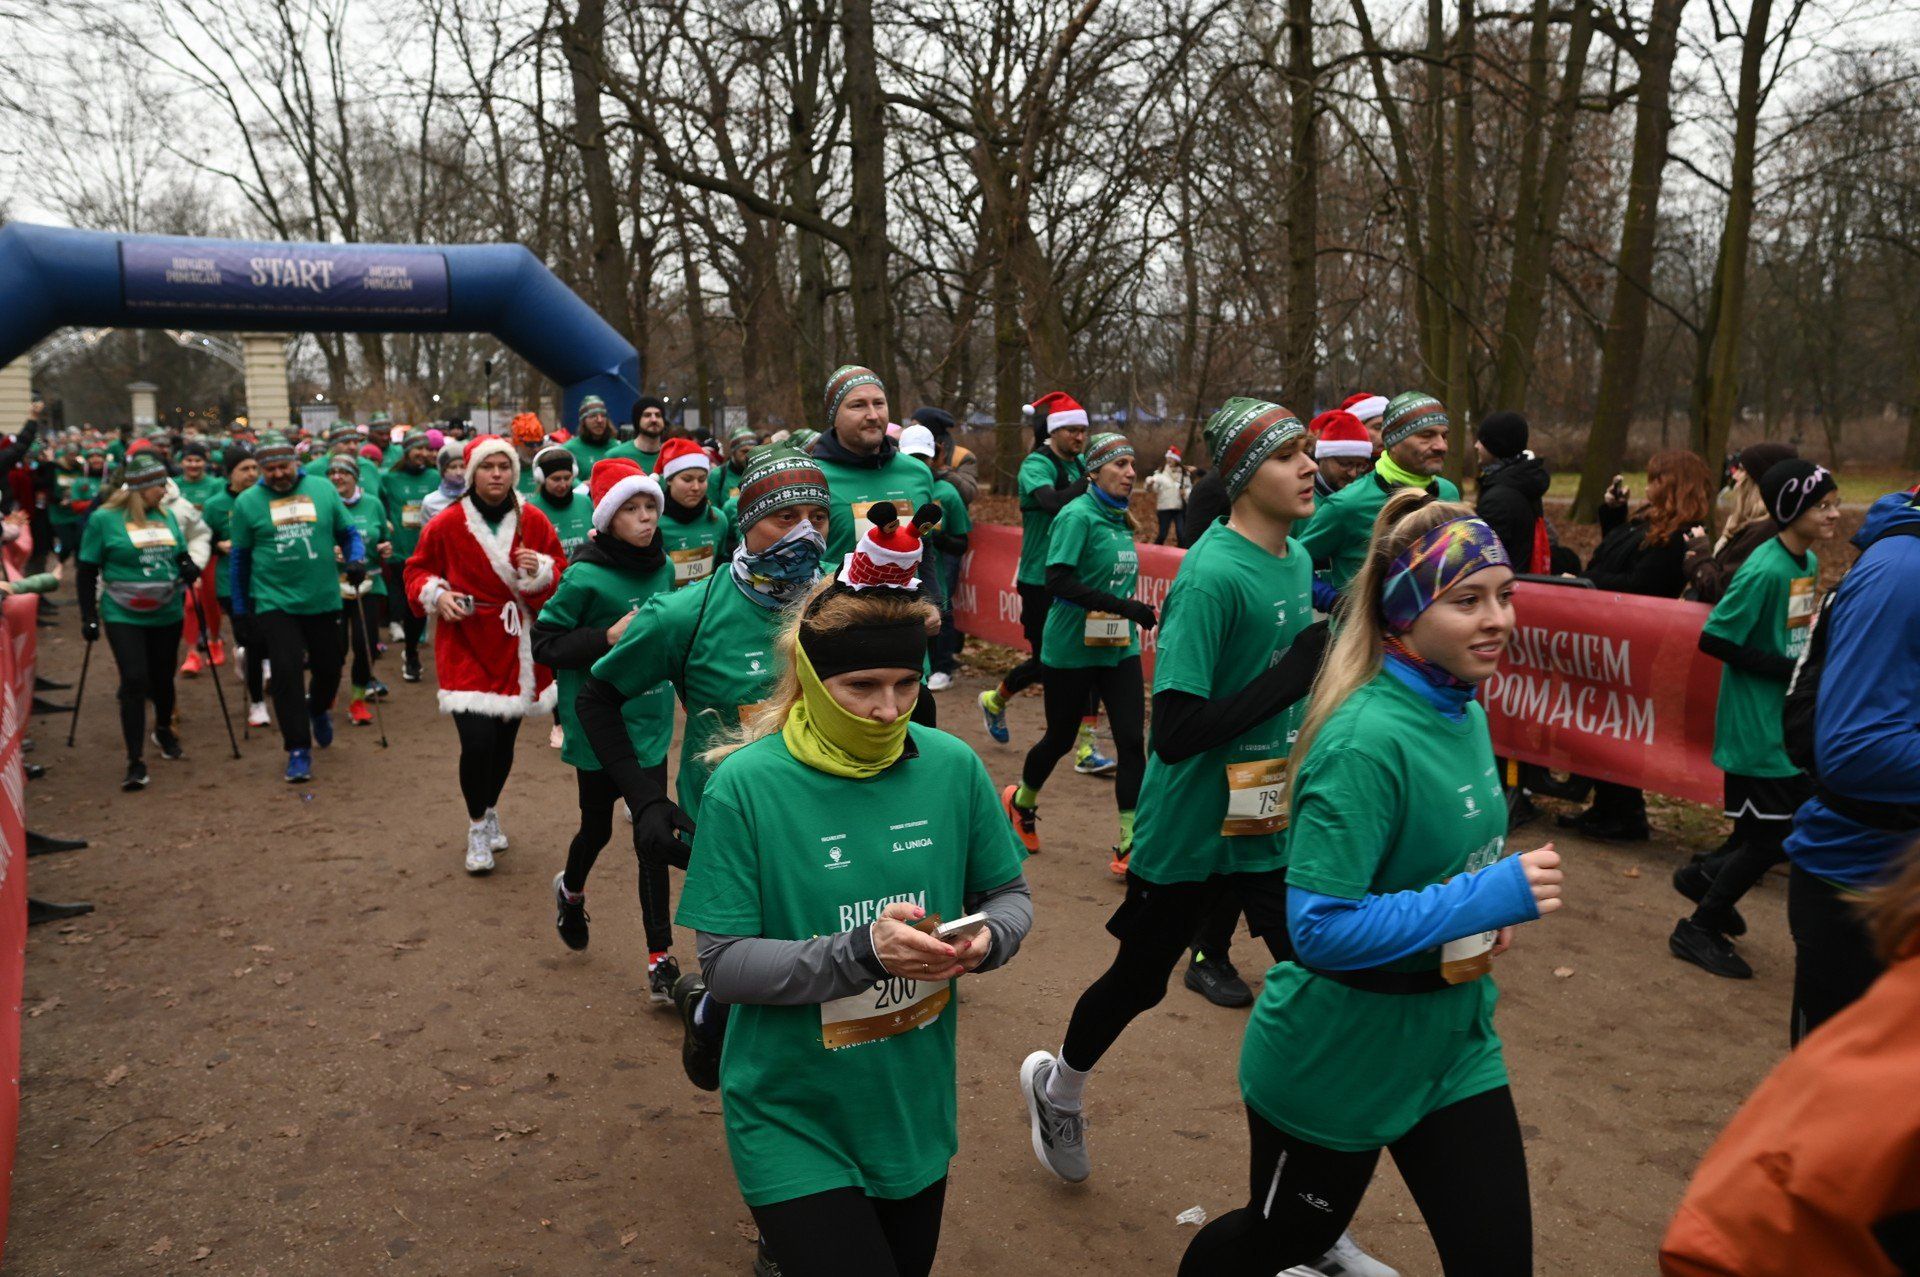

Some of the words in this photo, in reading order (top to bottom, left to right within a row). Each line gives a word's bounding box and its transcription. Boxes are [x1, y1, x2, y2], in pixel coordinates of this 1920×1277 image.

[250, 257, 335, 293] START
[1107, 623, 1119, 635] 117
[1505, 626, 1632, 687] BIEGIEM
[1484, 671, 1655, 745] POMAGAM
[905, 838, 933, 849] UNIQA
[874, 976, 916, 1009] 200
